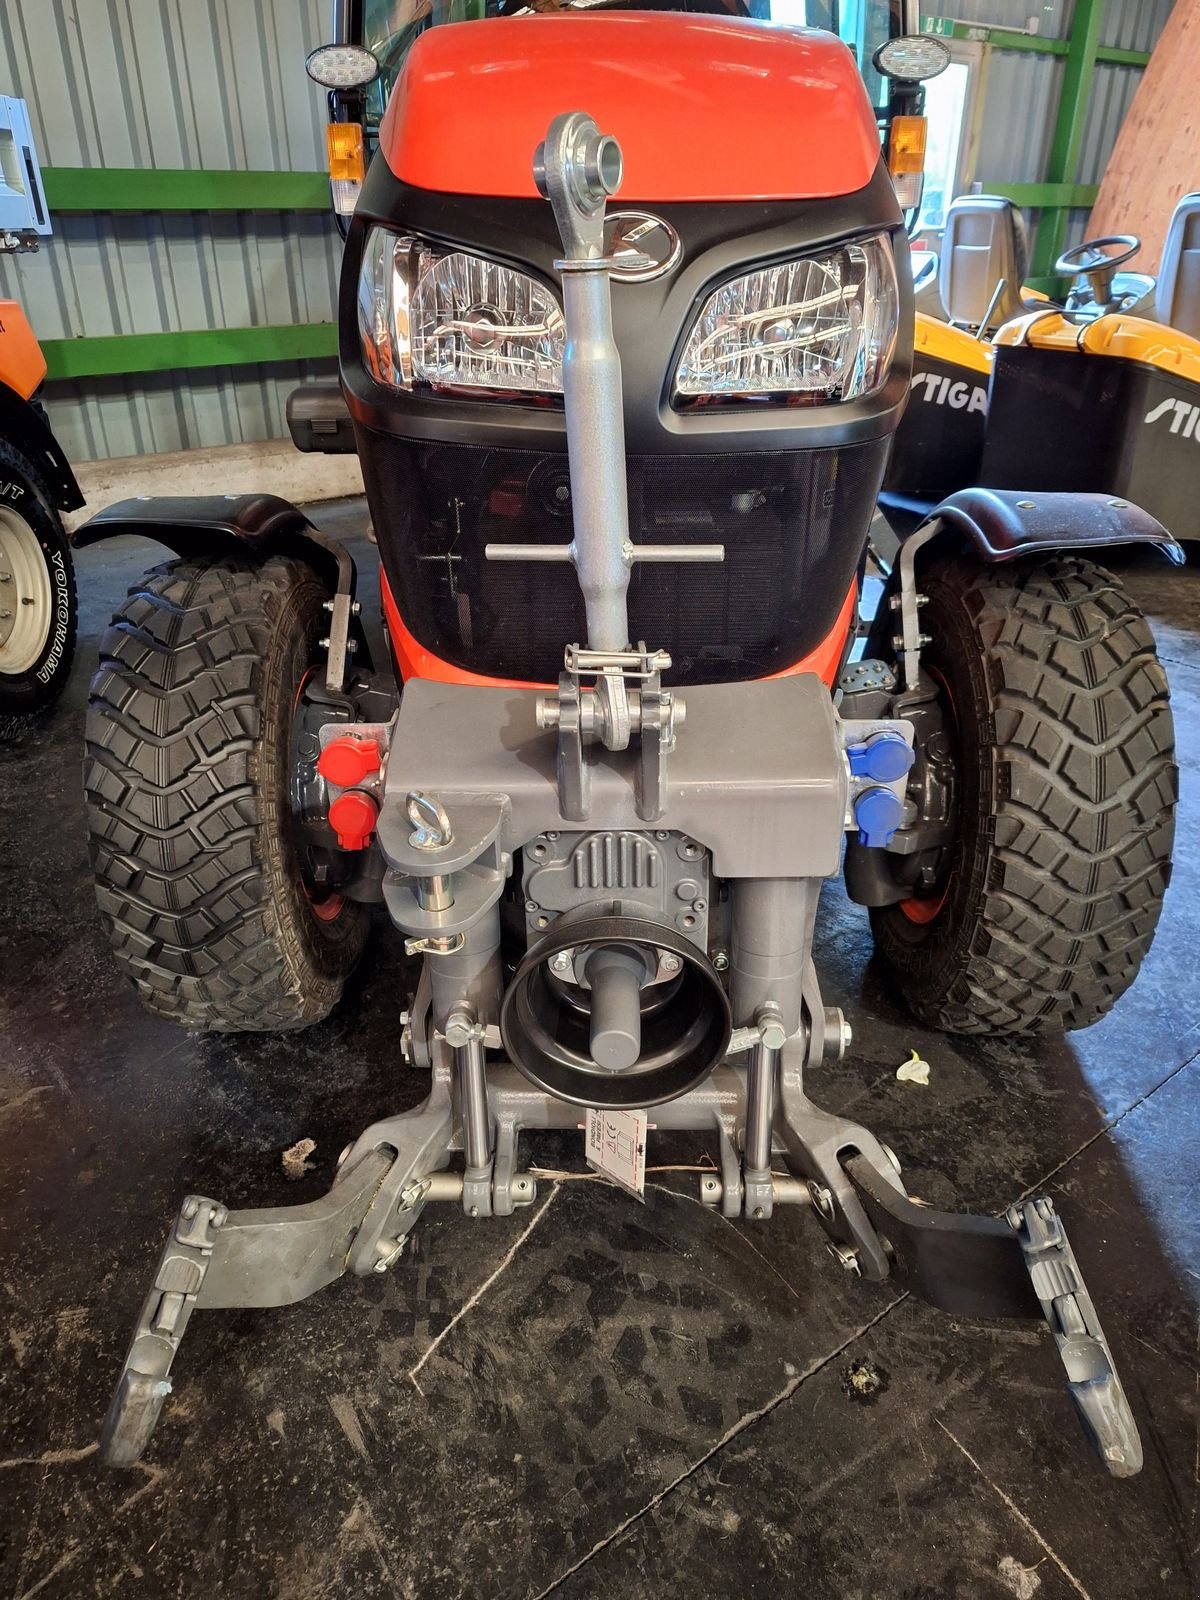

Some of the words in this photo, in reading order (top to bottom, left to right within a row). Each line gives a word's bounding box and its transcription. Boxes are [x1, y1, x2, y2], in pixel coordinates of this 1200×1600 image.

[911, 372, 990, 416] STIGA
[1144, 398, 1200, 443] STI
[36, 550, 69, 684] YOKOHAMA
